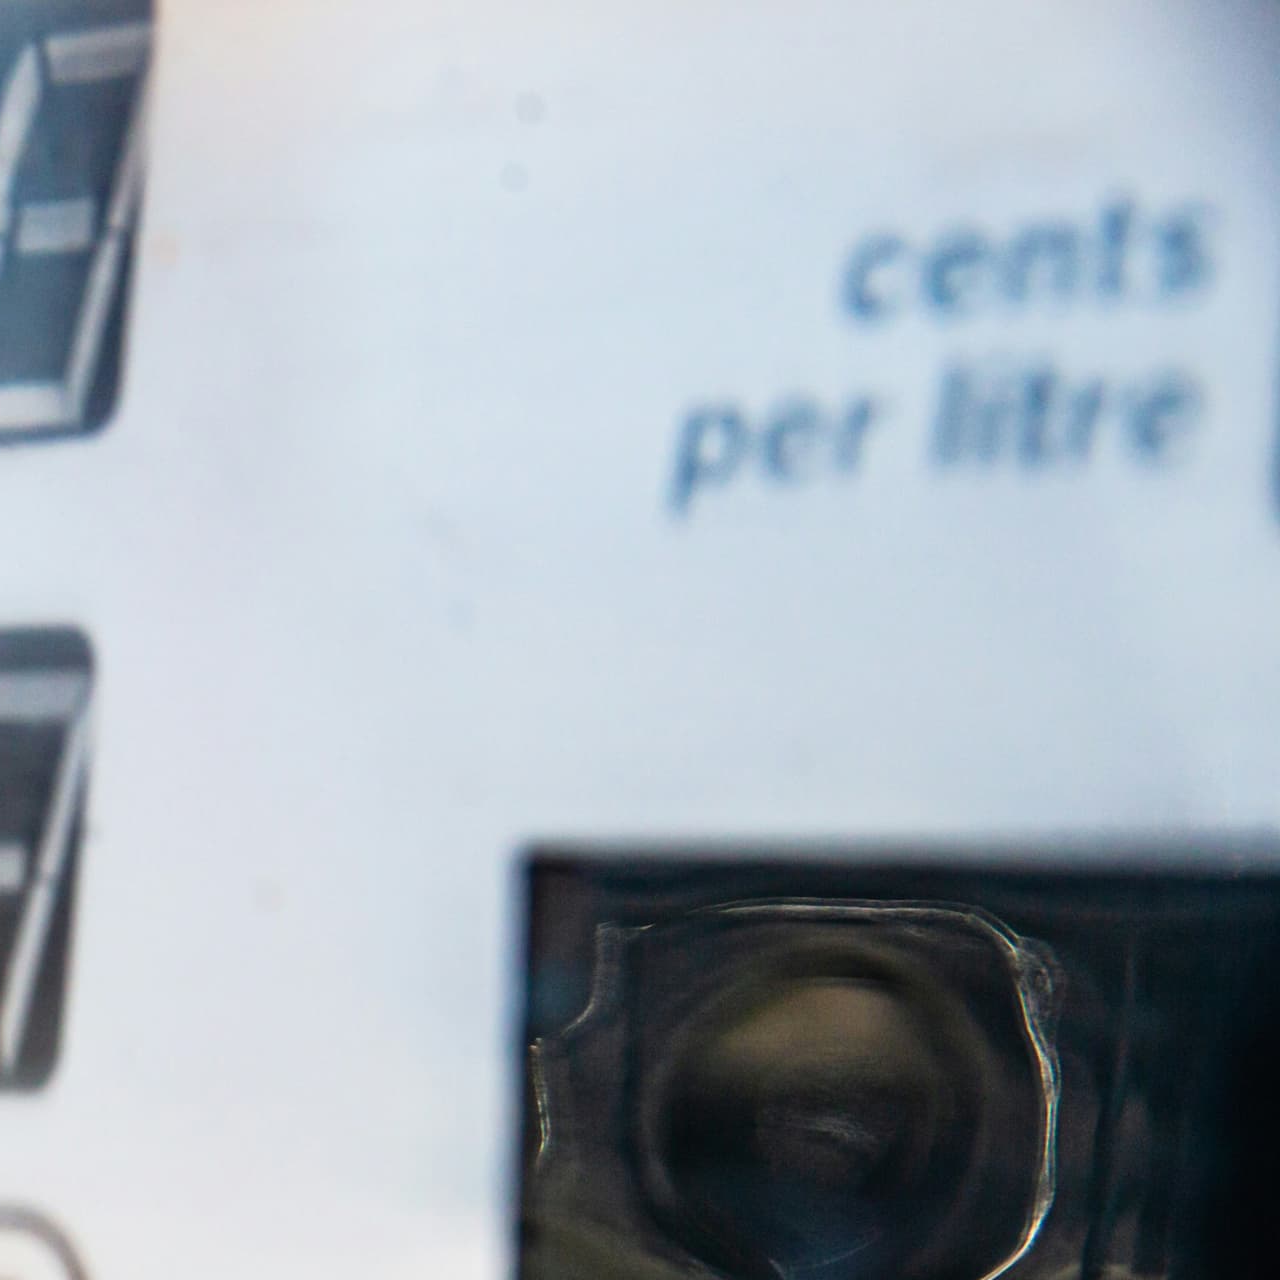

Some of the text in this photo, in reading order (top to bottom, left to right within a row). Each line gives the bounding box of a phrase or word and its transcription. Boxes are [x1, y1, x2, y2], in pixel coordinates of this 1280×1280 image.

[840, 188, 1218, 326] cents
[664, 358, 1204, 522] per litre
